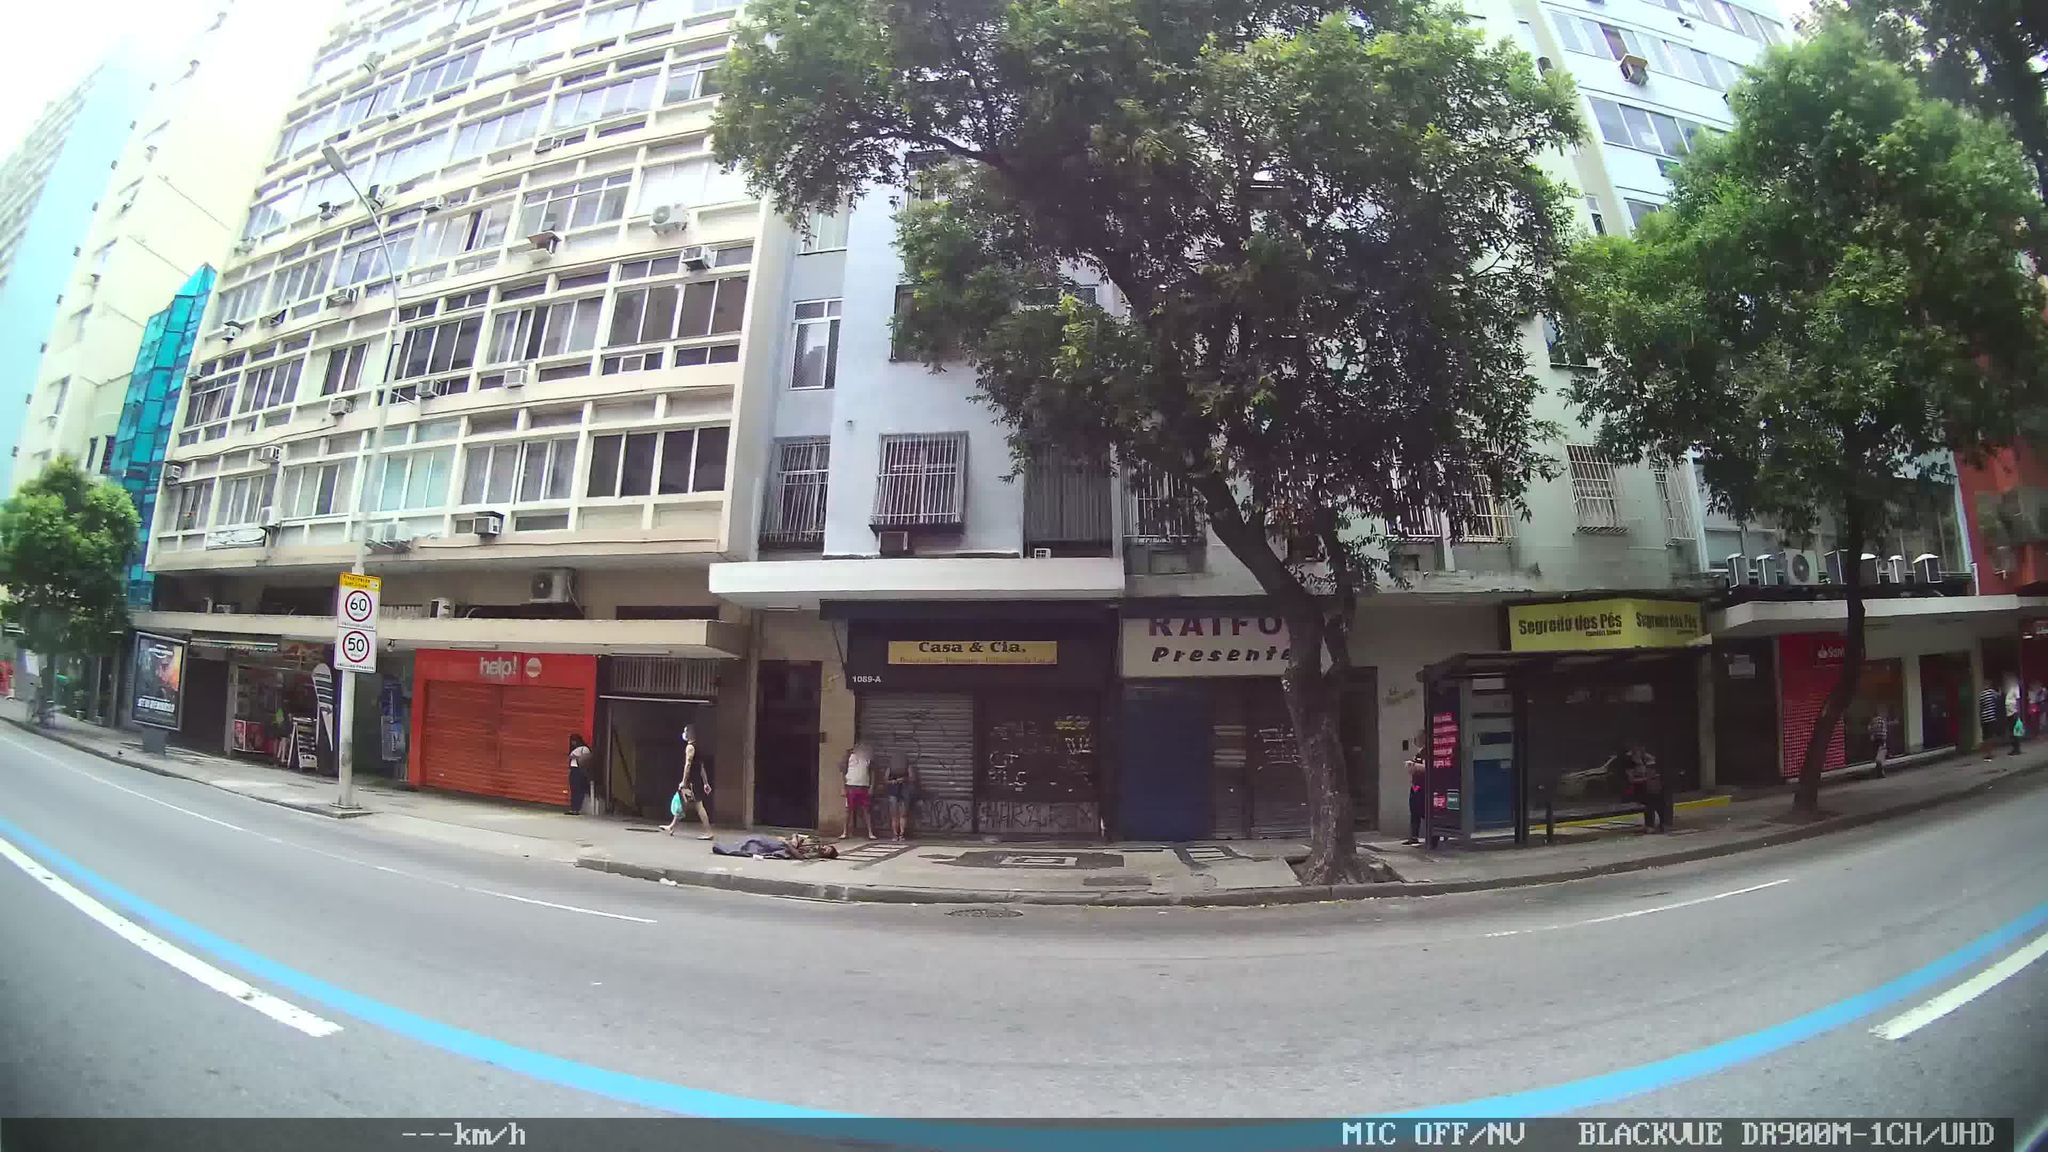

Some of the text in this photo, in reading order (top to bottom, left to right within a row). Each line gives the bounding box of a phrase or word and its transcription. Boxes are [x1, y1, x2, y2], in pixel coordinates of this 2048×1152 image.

[350, 598, 367, 612] 60
[1149, 617, 1283, 637] RAIFO
[1519, 616, 1572, 636] Segredo
[1574, 613, 1598, 631] dos
[1600, 611, 1622, 629] Pés
[348, 637, 365, 653] 50
[919, 641, 1026, 653] Casa & Cia.
[1151, 646, 1291, 662] Presente
[480, 656, 517, 681] help!
[852, 675, 882, 683] 1089-A
